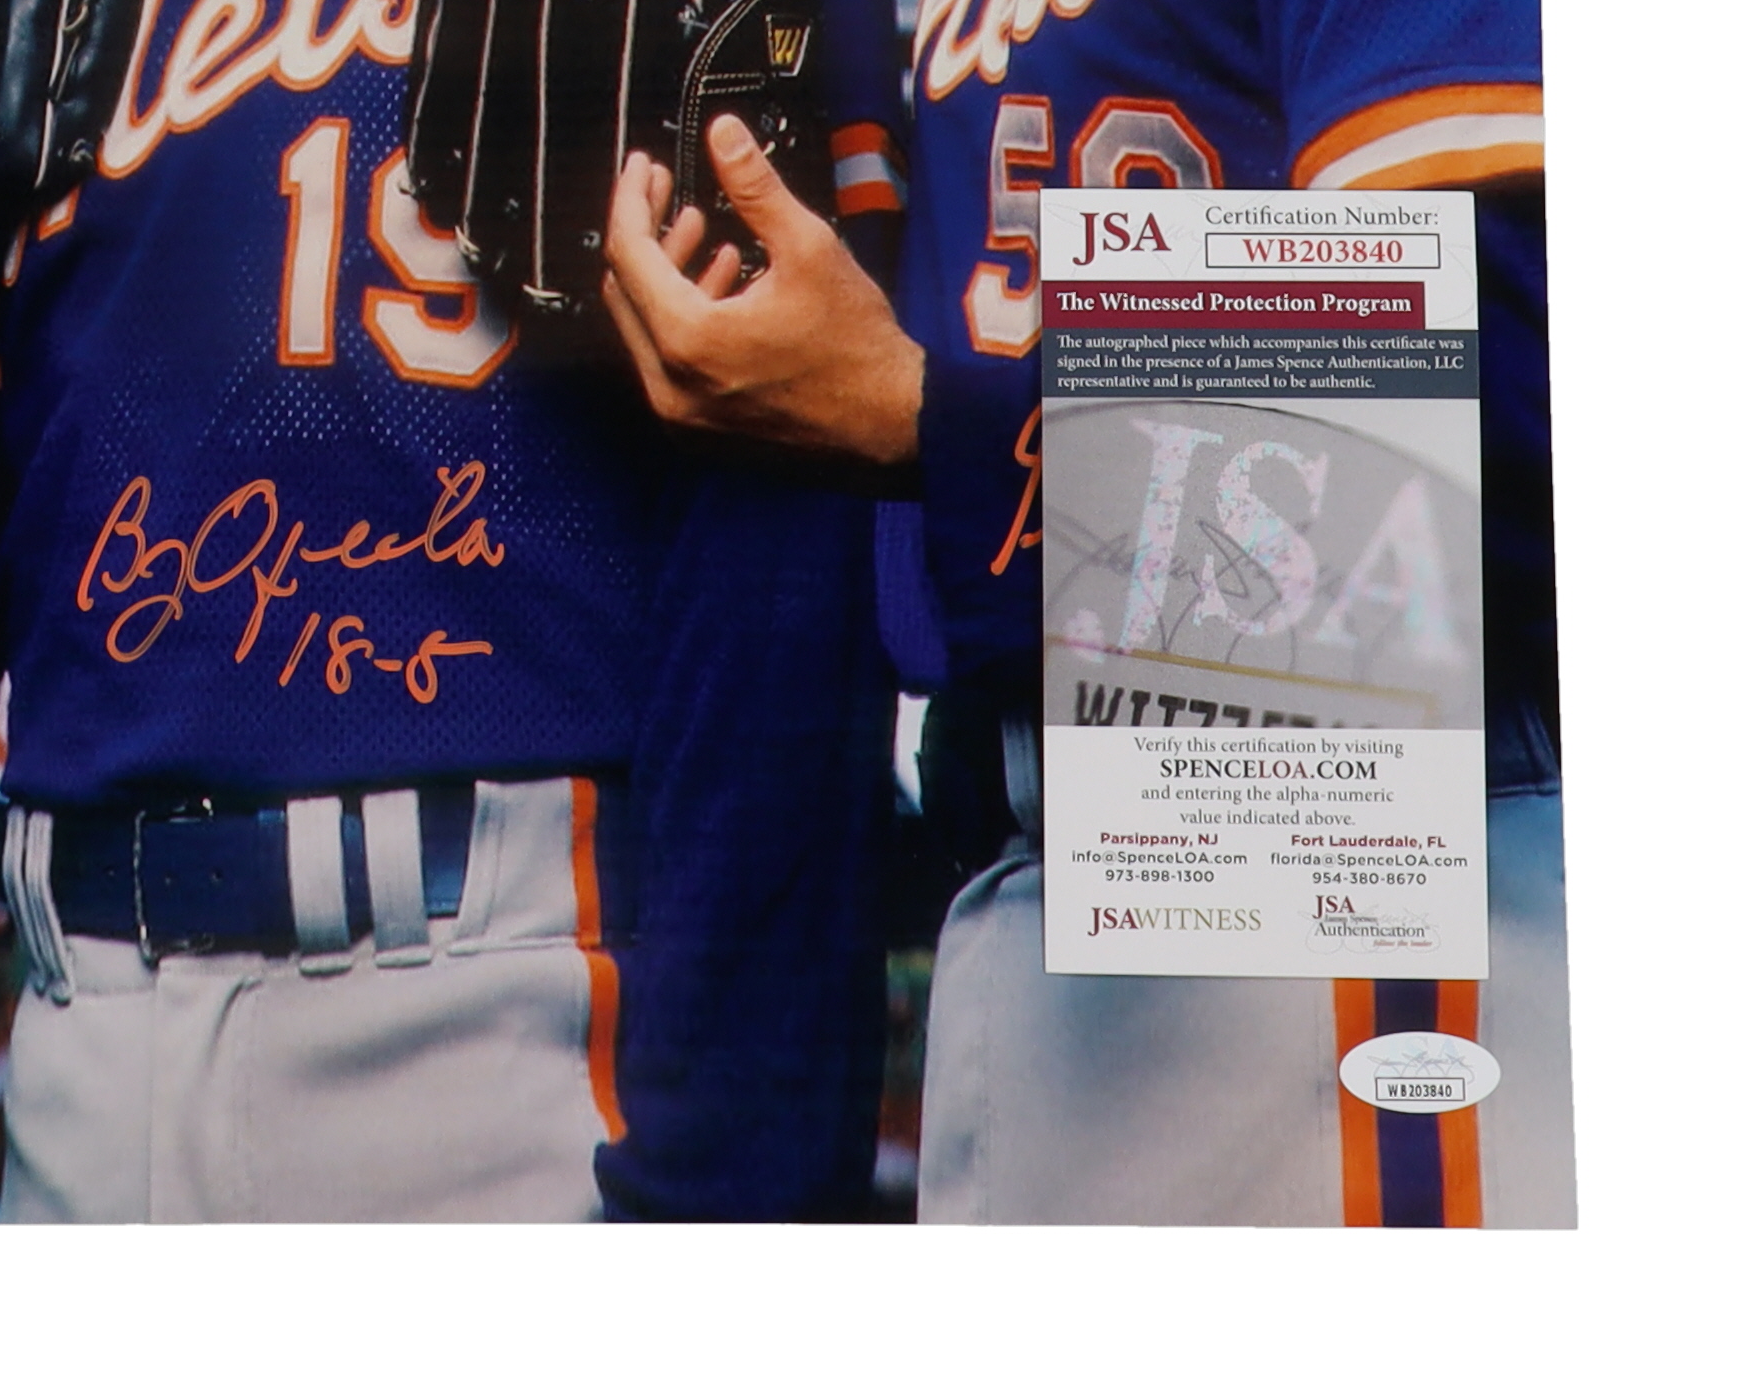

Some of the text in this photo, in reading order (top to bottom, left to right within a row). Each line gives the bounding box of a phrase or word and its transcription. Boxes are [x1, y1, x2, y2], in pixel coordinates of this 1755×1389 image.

[1205, 206, 1439, 226] Certification Number:
[1072, 212, 1171, 266] JSA
[1242, 238, 1403, 263] WB203840
[1057, 291, 1412, 317] The Witnessed Protection Program
[1057, 334, 1465, 353] The autographed piece which accompanies this certificate was
[1057, 354, 1465, 372] signed in the presence of a James Spence Authentication, LLC
[1057, 374, 1376, 391] representative and is guaranteed to be authentic.
[1061, 417, 1469, 670] JSA
[1133, 736, 1404, 759] Verify this certification by visiting
[1160, 759, 1377, 780] SPENCELOA.COM
[1141, 784, 1395, 805] and entering the alpha-numeric
[1180, 809, 1356, 826] value indicated above.
[1100, 832, 1219, 847] Parsippany, NJ
[1291, 834, 1447, 849] Fort Lauderdale, FL
[1072, 850, 1248, 865] info@SpenceLOA.com
[1270, 852, 1468, 868] florida@SpenceLOA.com
[1105, 869, 1215, 883] 973-898-1300
[1312, 872, 1427, 885] 954-380-8670
[1312, 895, 1356, 919] JSA
[1314, 921, 1425, 937] Authentication
[1387, 1084, 1452, 1098] WB203840
